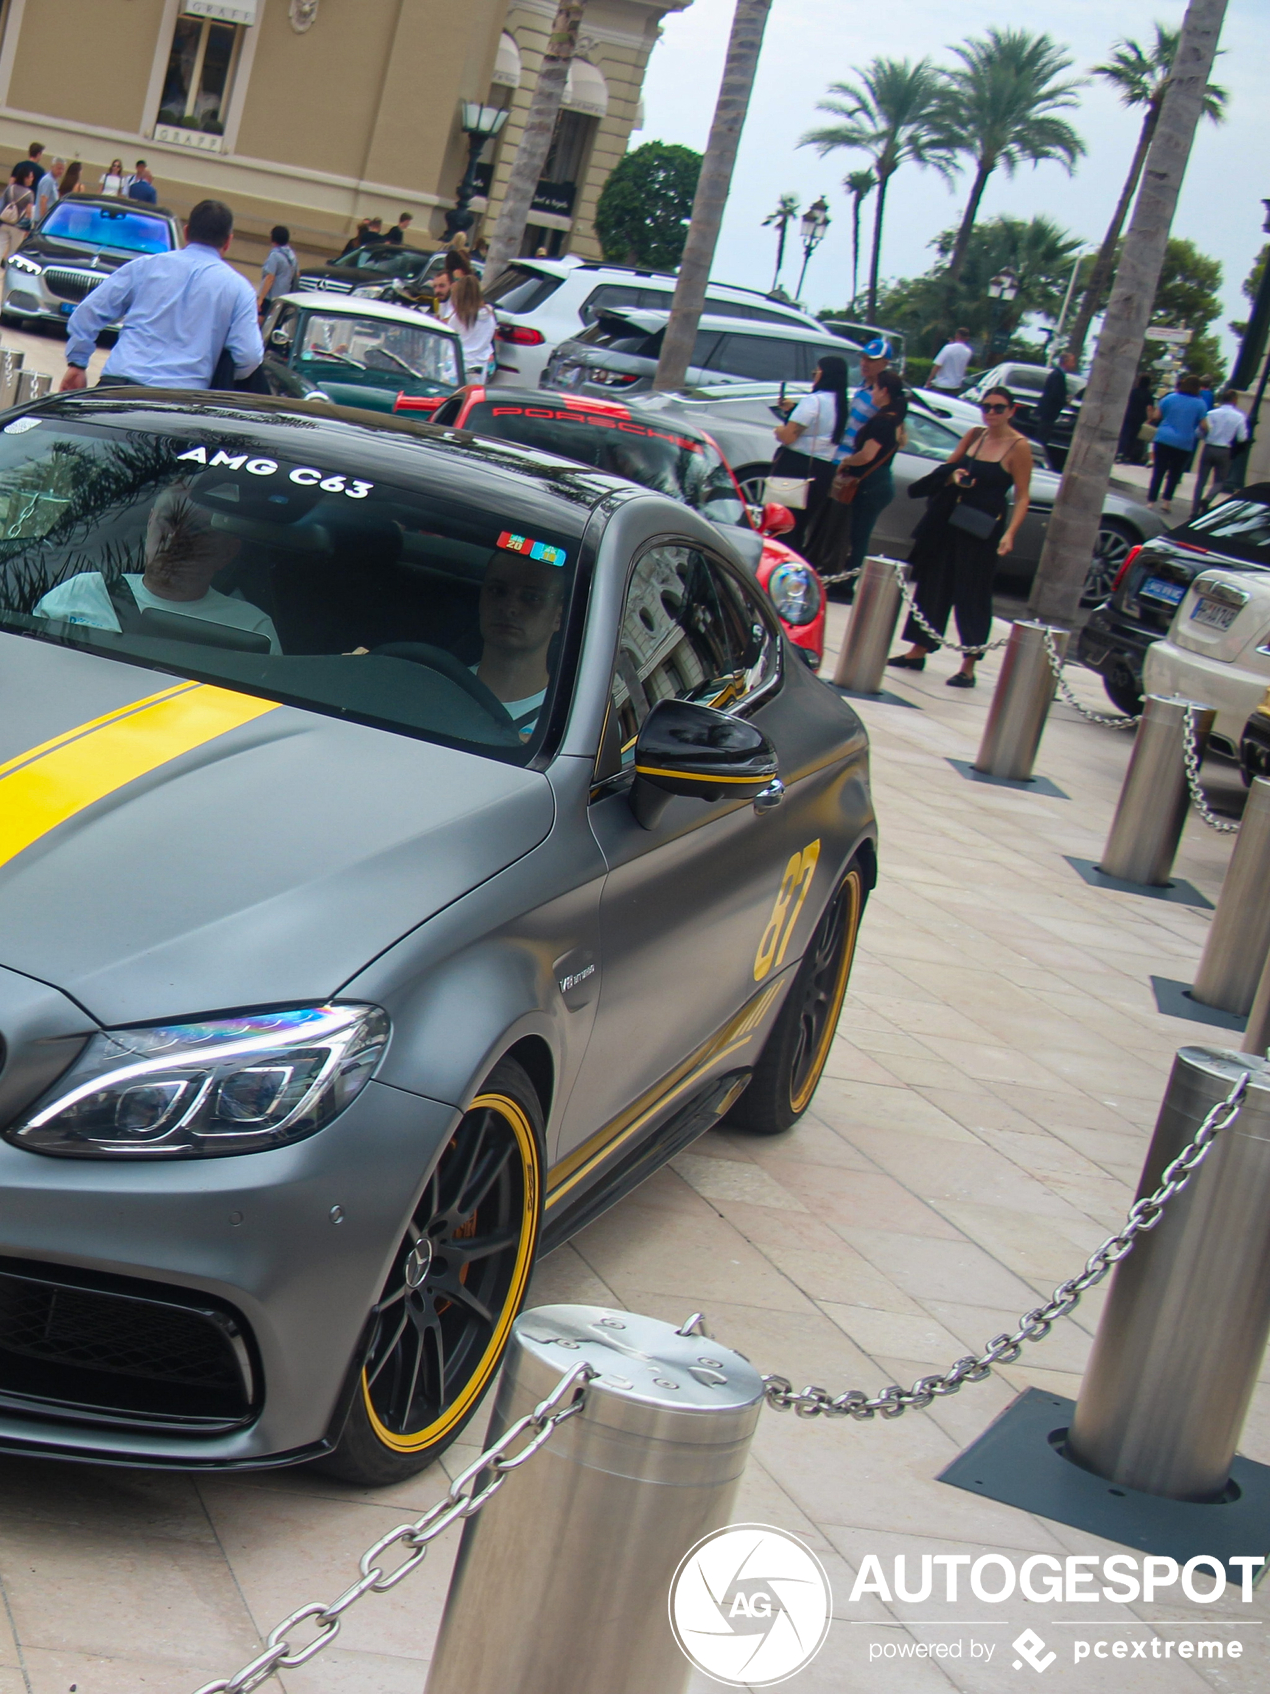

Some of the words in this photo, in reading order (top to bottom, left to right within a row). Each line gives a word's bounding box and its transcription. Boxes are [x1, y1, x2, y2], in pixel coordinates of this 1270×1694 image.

[193, 2, 251, 21] GRAFF
[159, 129, 218, 147] GRAFF
[177, 446, 279, 476] AMG
[289, 467, 374, 499] C63
[506, 540, 523, 551] 20
[754, 838, 821, 981] 87
